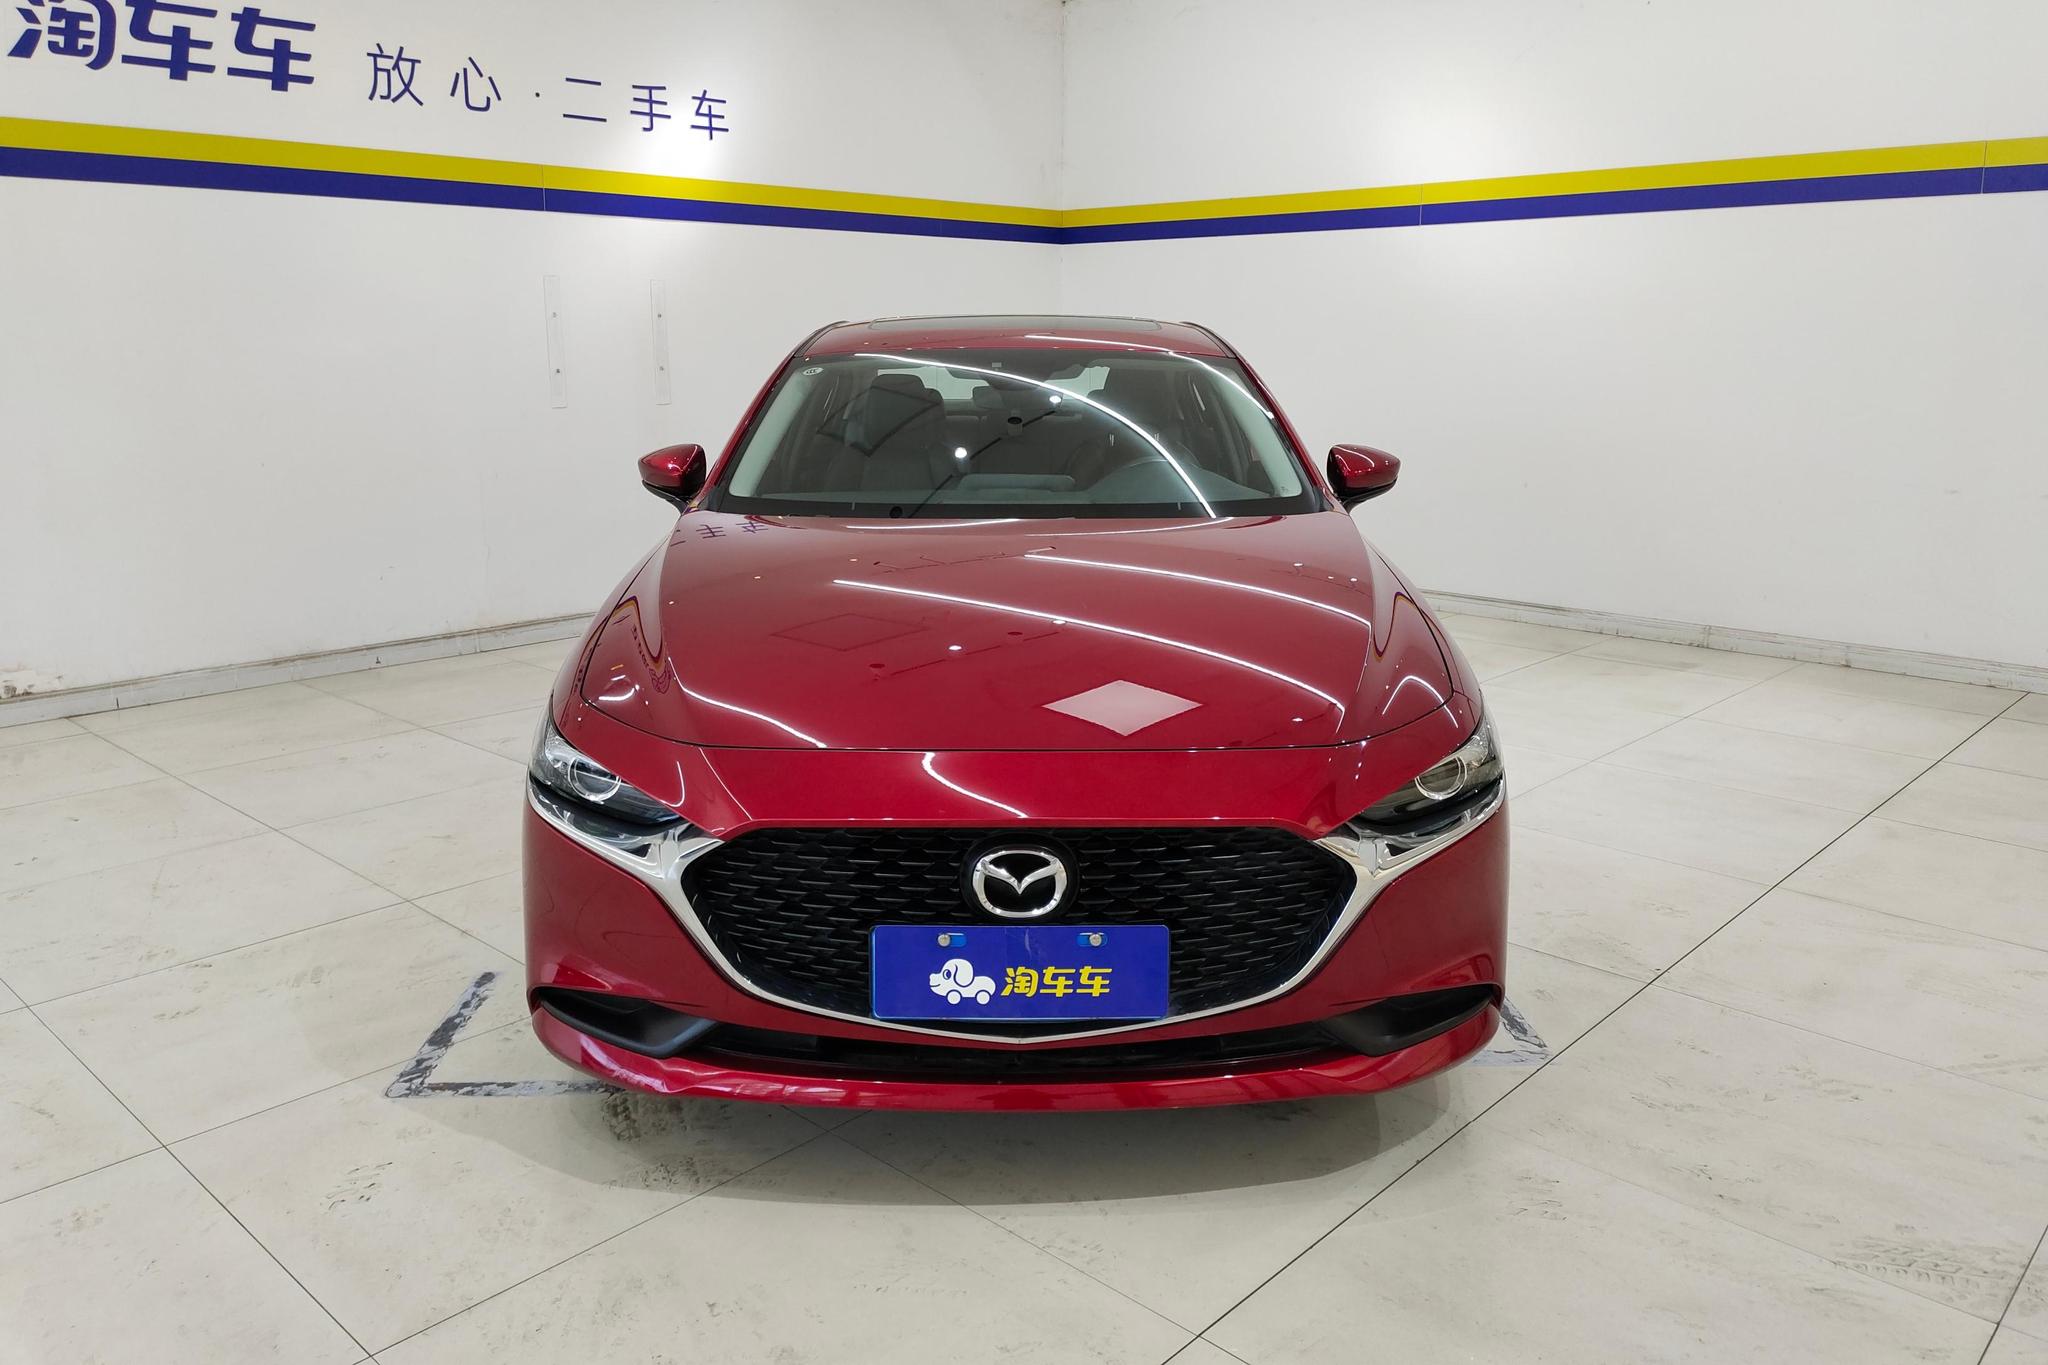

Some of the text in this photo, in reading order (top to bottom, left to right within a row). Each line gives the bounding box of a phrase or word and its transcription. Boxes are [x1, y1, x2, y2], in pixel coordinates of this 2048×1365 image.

[7, 0, 316, 92] 淘车车
[1001, 965, 1112, 998] 淘车车
